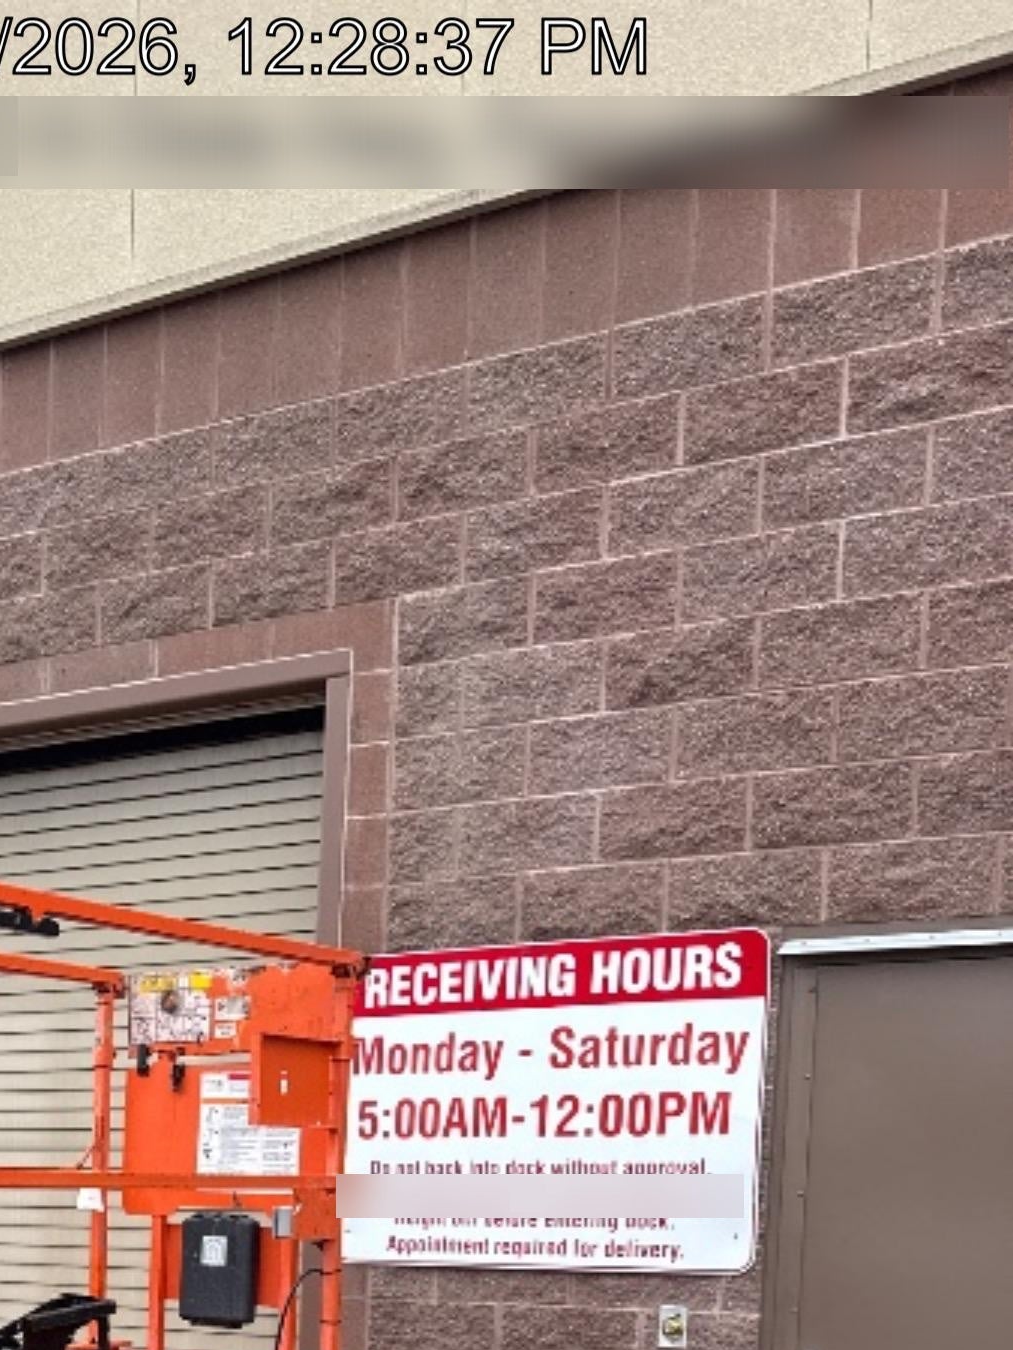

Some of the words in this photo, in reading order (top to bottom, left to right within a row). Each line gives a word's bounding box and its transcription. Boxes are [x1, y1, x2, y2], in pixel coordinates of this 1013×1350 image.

[364, 952, 576, 1008] RECEIVING
[590, 941, 743, 995] HOURS
[353, 1033, 504, 1080] Monday
[549, 1022, 750, 1074] Saturday
[357, 1091, 732, 1140] 5:00AM-12:00PM
[386, 1235, 489, 1256] Appointment
[493, 1238, 567, 1258] required
[574, 1238, 598, 1257] for
[604, 1239, 684, 1263] delivery.
